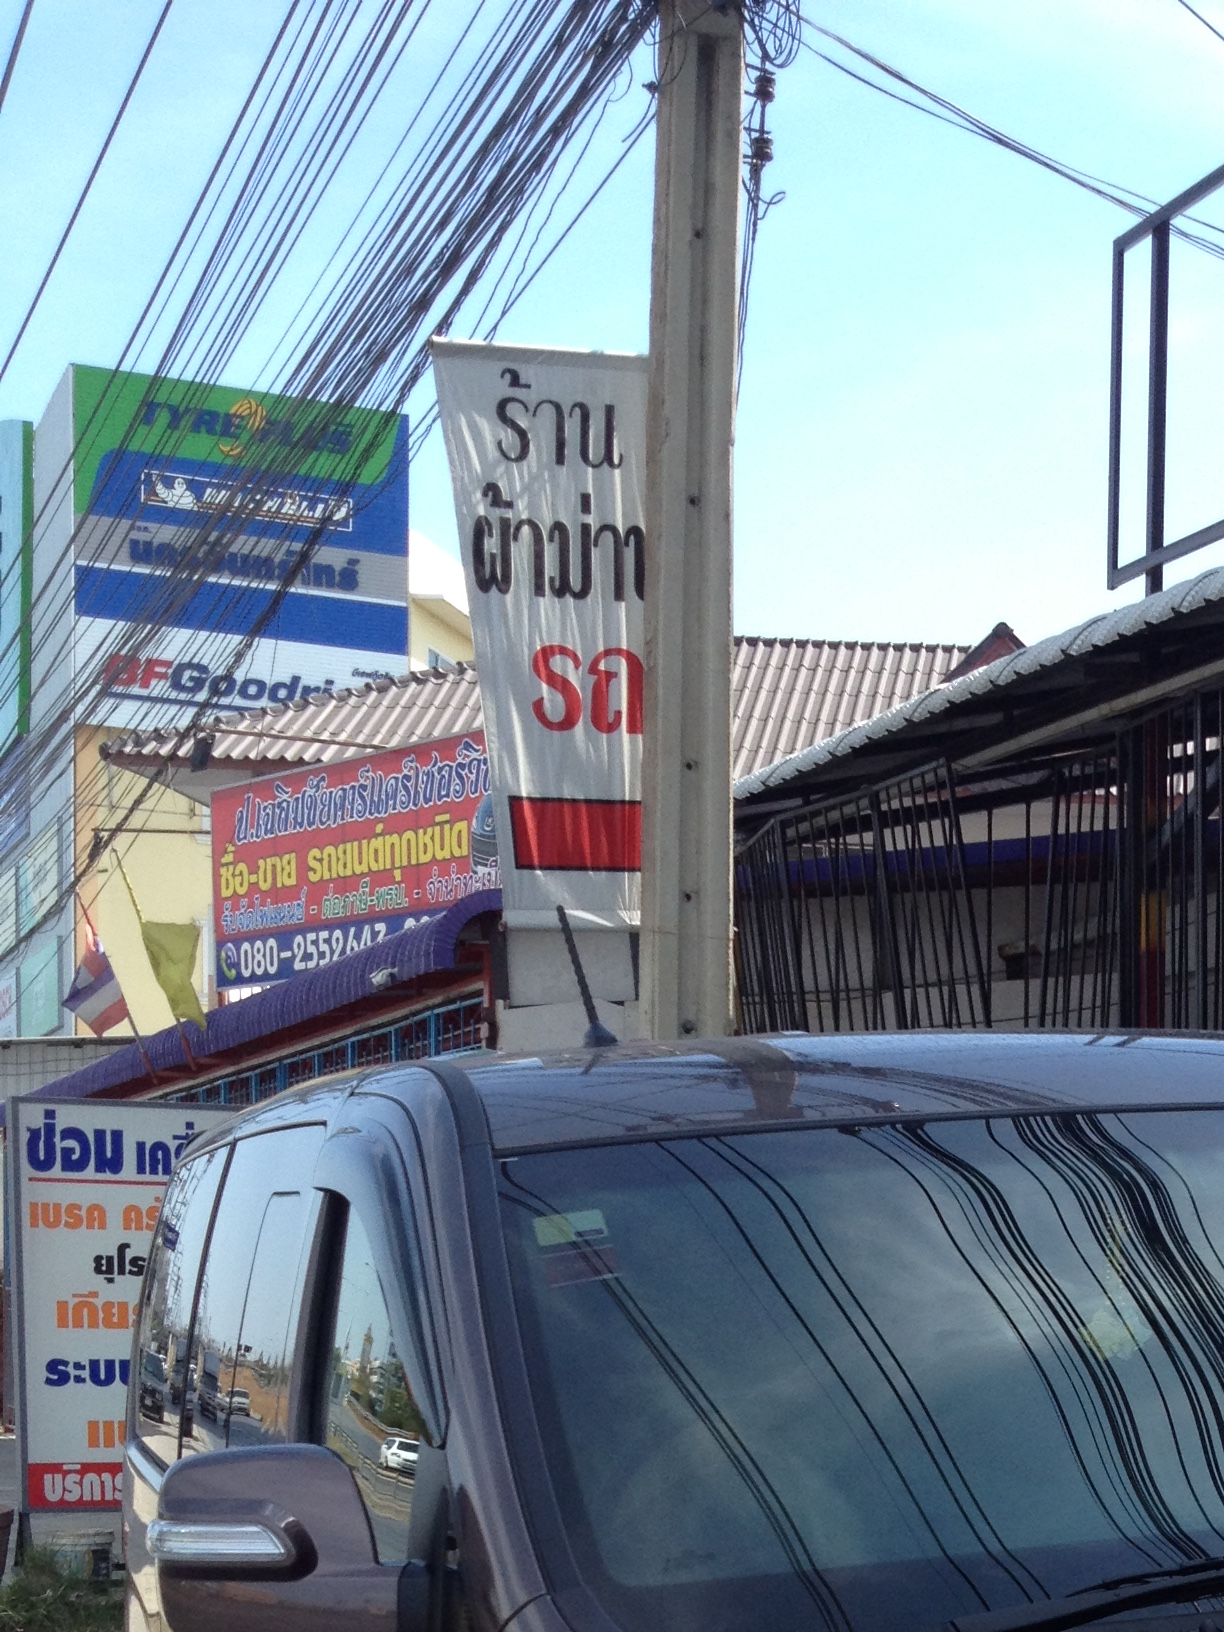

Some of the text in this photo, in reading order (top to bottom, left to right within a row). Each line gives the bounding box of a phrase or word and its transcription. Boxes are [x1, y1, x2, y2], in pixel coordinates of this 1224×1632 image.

[496, 367, 624, 470] ร้าน
[26, 1109, 124, 1175] ซ่อม
[29, 1202, 107, 1231] เบรค
